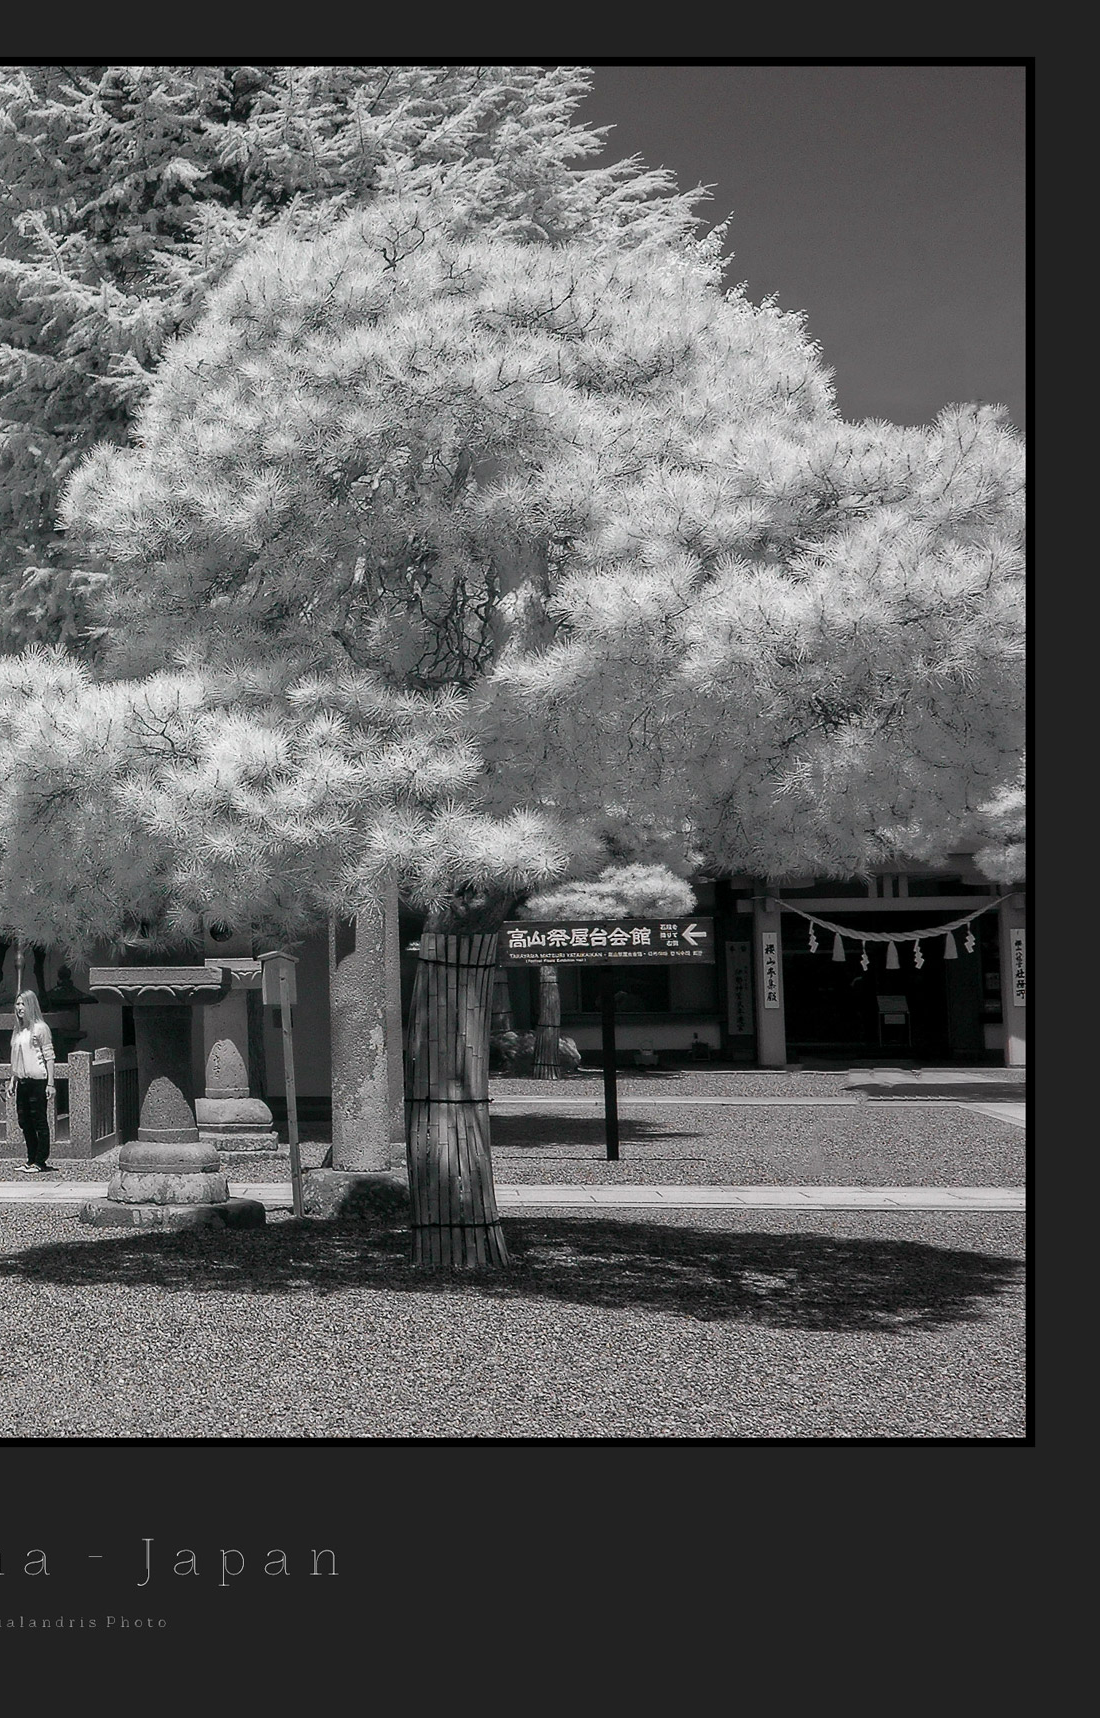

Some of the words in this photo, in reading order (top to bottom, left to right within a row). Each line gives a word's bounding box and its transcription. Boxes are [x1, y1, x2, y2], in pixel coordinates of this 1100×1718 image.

[506, 927, 651, 949] 高山祭屋台会館
